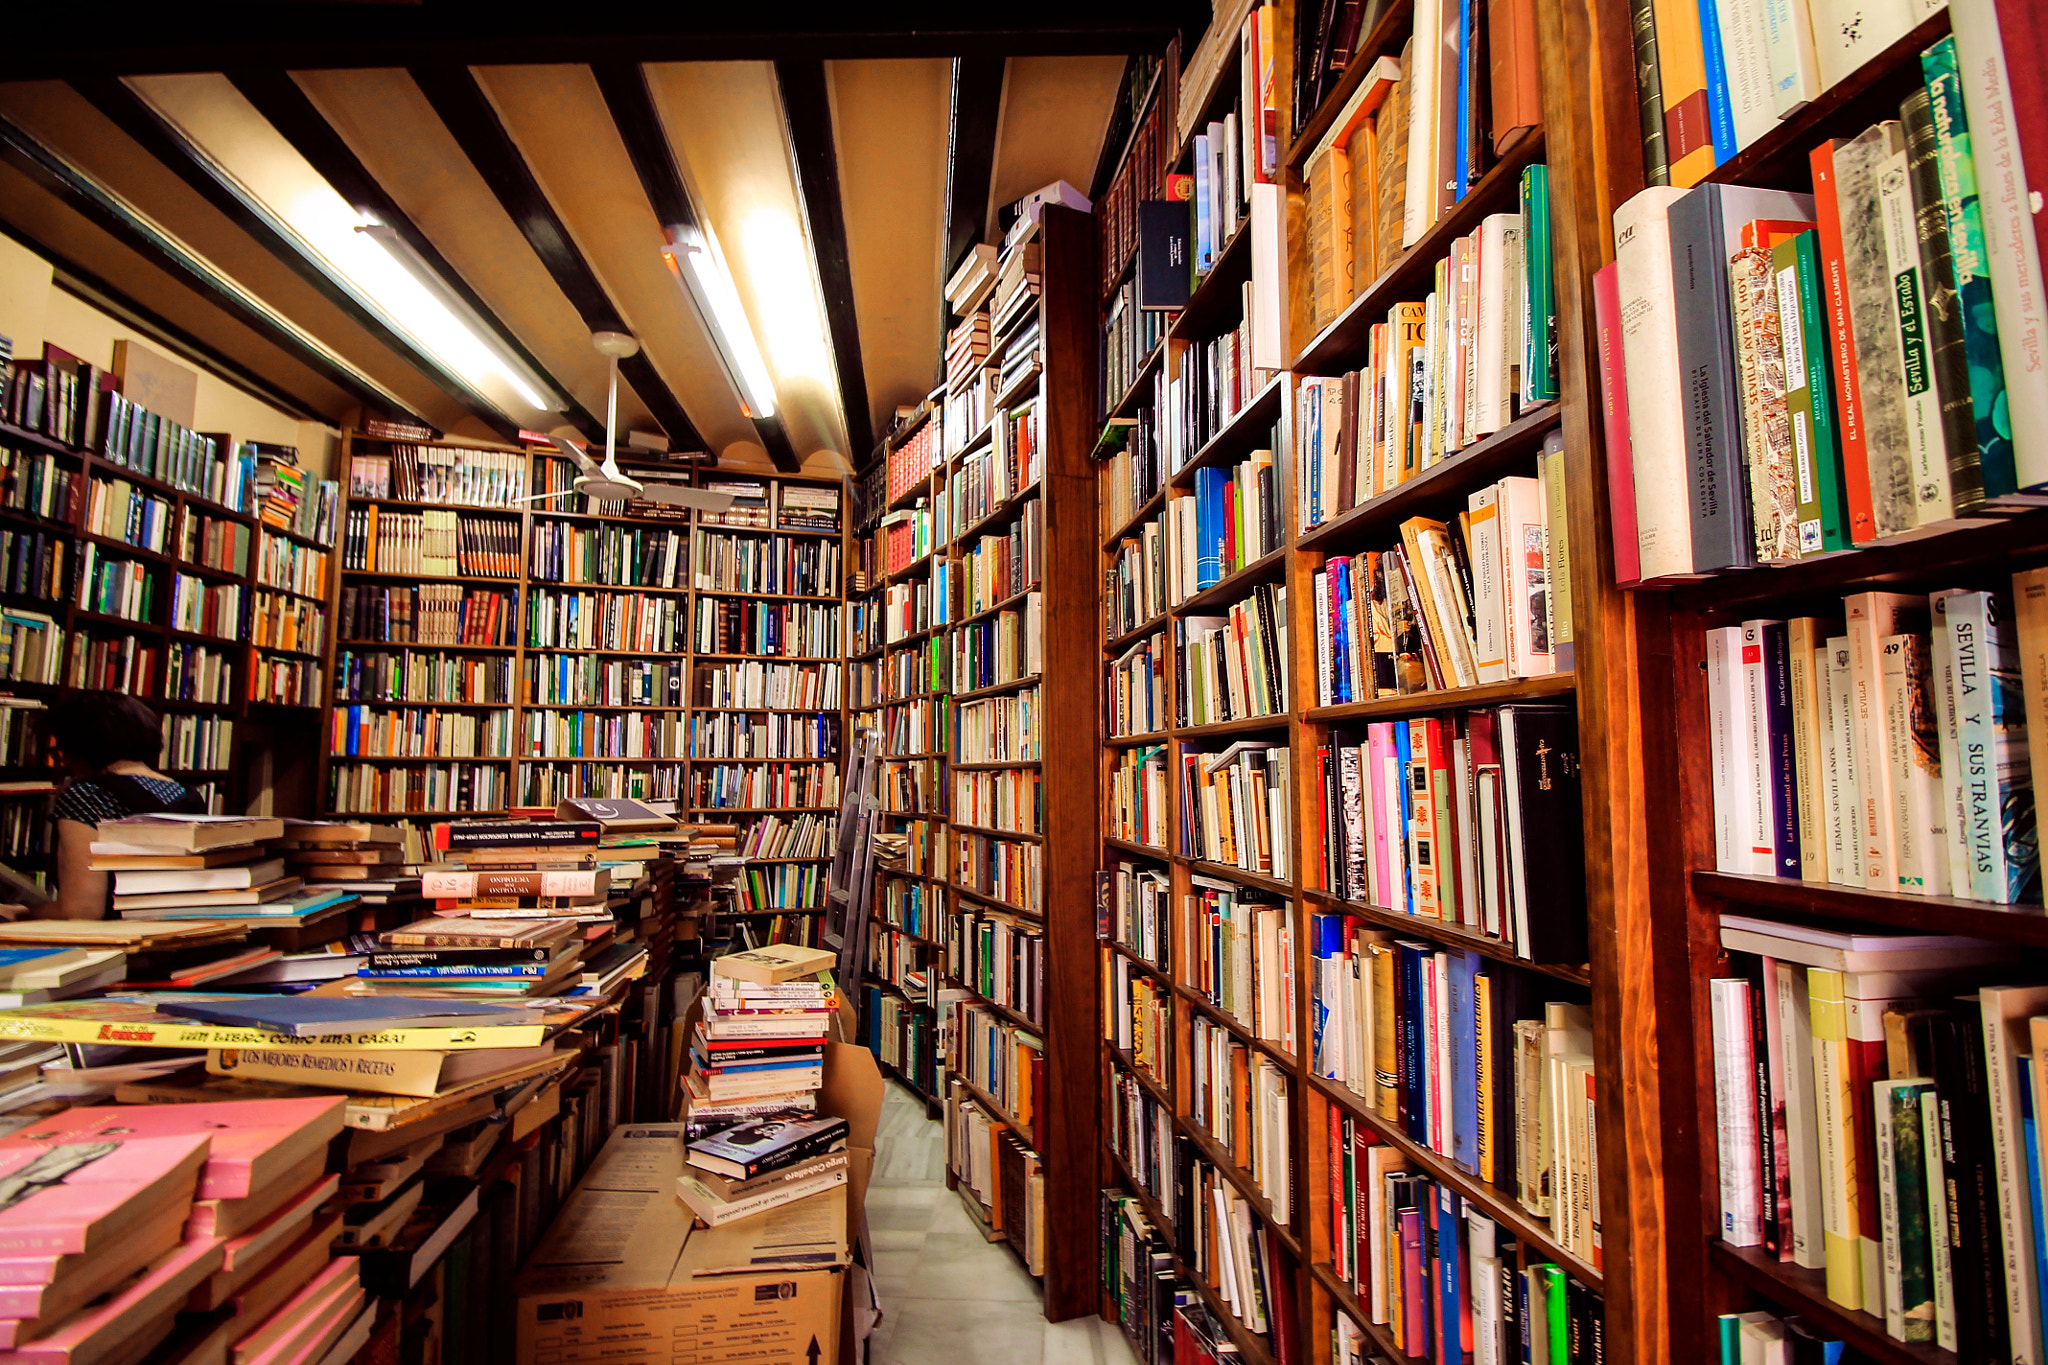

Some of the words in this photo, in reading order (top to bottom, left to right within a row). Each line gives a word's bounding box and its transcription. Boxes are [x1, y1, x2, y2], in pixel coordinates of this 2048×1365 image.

[1982, 58, 1999, 99] Media
[1988, 101, 2006, 132] Edad
[1995, 138, 2007, 151] la
[1996, 152, 2010, 168] de
[1930, 74, 1951, 96] la
[1952, 222, 1979, 286] sevilla
[2001, 171, 2016, 203] fines
[2008, 215, 2028, 288] mercaderes
[1738, 277, 1747, 303] HOY
[1831, 259, 1843, 306] CLEMENTE
[1896, 274, 1914, 316] Estado
[1740, 308, 1748, 316] Y
[2020, 292, 2033, 312] sus
[1836, 307, 1845, 326] SAN
[1602, 327, 1610, 362] Sevilla
[1742, 320, 1752, 350] AYER
[1838, 328, 1847, 340] DE
[1906, 337, 1922, 345] y
[2022, 328, 2041, 372] Sevilla
[1699, 365, 1707, 376] La
[1746, 354, 1759, 405] SEVILLA
[1841, 343, 1853, 401] MONASTERIO
[1905, 348, 1923, 392] Sevilla
[1700, 377, 1711, 409] Iglesia
[1702, 411, 1712, 425] del
[1847, 403, 1855, 426] REAL
[1704, 427, 1716, 468] Salvador
[1849, 428, 1857, 440] EL
[1707, 470, 1716, 482] de
[1699, 466, 1707, 519] COLEGIATA
[1708, 484, 1718, 516] Sevilla
[1557, 539, 1565, 569] Flores
[1558, 572, 1566, 593] Lola
[1561, 620, 1569, 637] Bio
[1883, 643, 1900, 655] 49
[1956, 622, 1978, 696] SEVILLA
[1323, 693, 1328, 701] LA
[1858, 680, 1868, 719] SEVILLA
[1965, 713, 1981, 725] Y
[1968, 743, 1985, 775] SUS
[1783, 772, 1790, 783] de
[1829, 747, 1840, 812] SEVILLANOS
[1784, 784, 1793, 830] Hermandad
[1786, 832, 1794, 843] La
[1833, 816, 1843, 852] TEMAS
[1971, 780, 1992, 873] TRANVIAS
[1851, 1004, 1857, 1014] 2
[241, 1050, 260, 1064] LOS
[262, 1051, 300, 1069] MEJORES
[301, 1053, 347, 1072] REMEDIOS
[356, 1059, 396, 1077] RECETAS
[784, 1163, 825, 1181] Caballero
[825, 1155, 848, 1169] Largo
[1763, 1193, 1772, 1220] TRIANA
